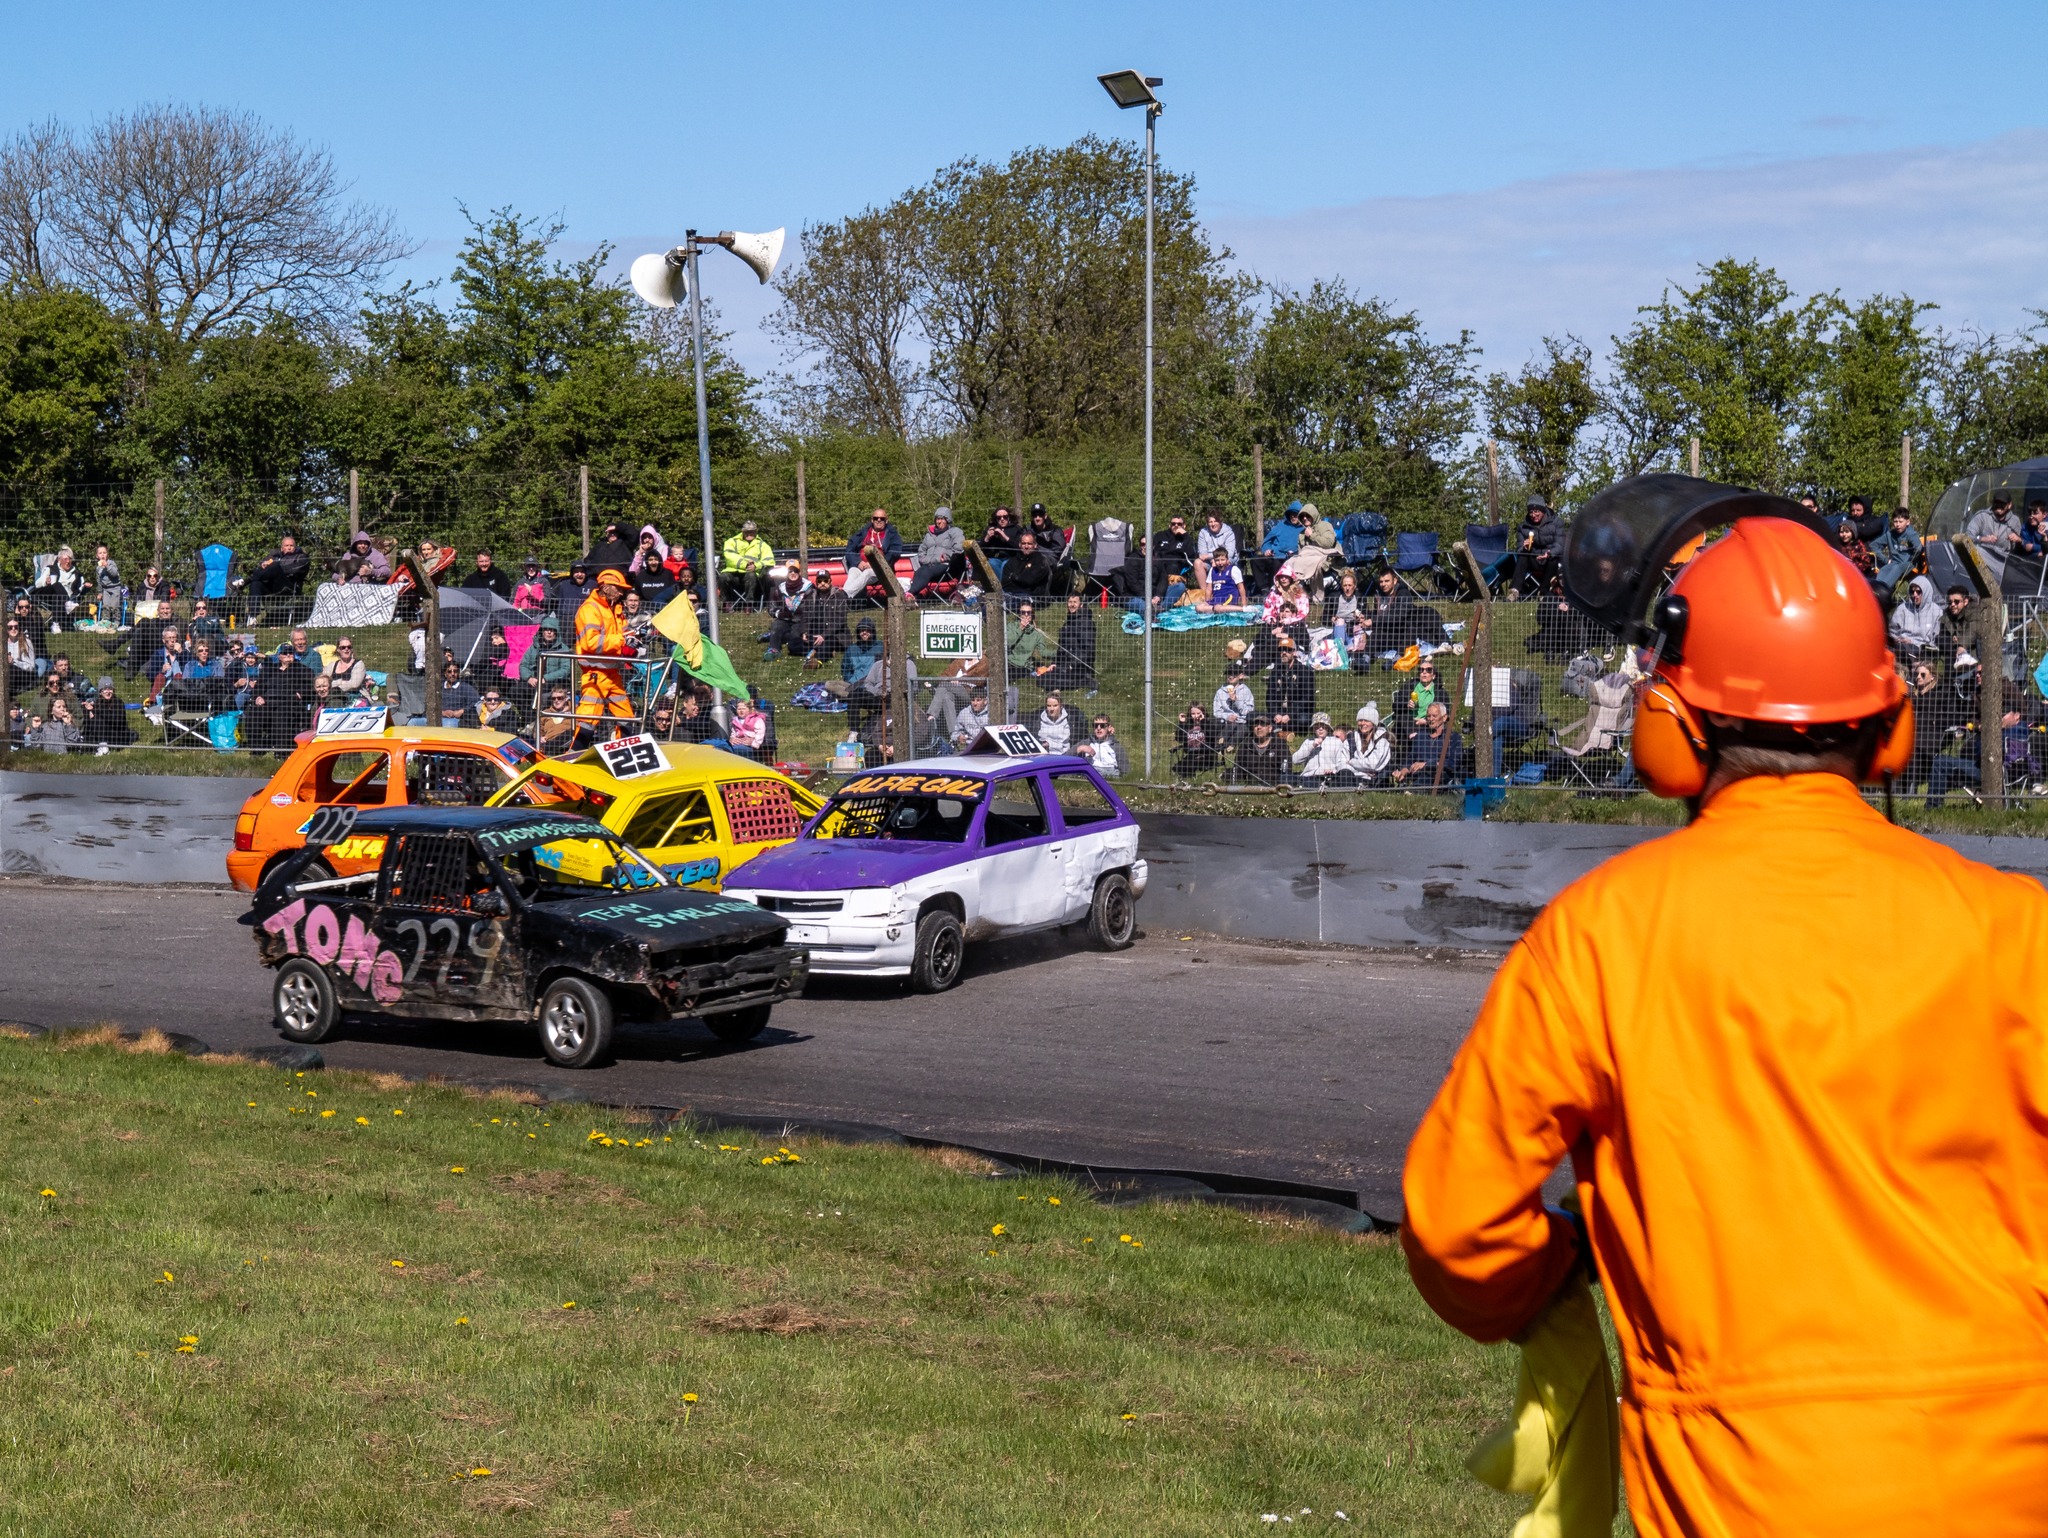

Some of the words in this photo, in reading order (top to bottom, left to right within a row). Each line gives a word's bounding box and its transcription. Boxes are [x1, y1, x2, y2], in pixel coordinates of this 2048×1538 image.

[925, 624, 978, 633] EMERGENCY
[930, 636, 956, 649] EXIT
[318, 711, 386, 734] 16
[603, 736, 642, 752] DEXTER
[998, 731, 1042, 755] 168
[607, 742, 661, 778] 23
[838, 776, 927, 795] ALFIE
[920, 777, 985, 797] GILL
[306, 806, 359, 845] 229
[329, 838, 385, 860] 4X4
[578, 902, 653, 922] TEAM
[396, 918, 505, 992] 229
